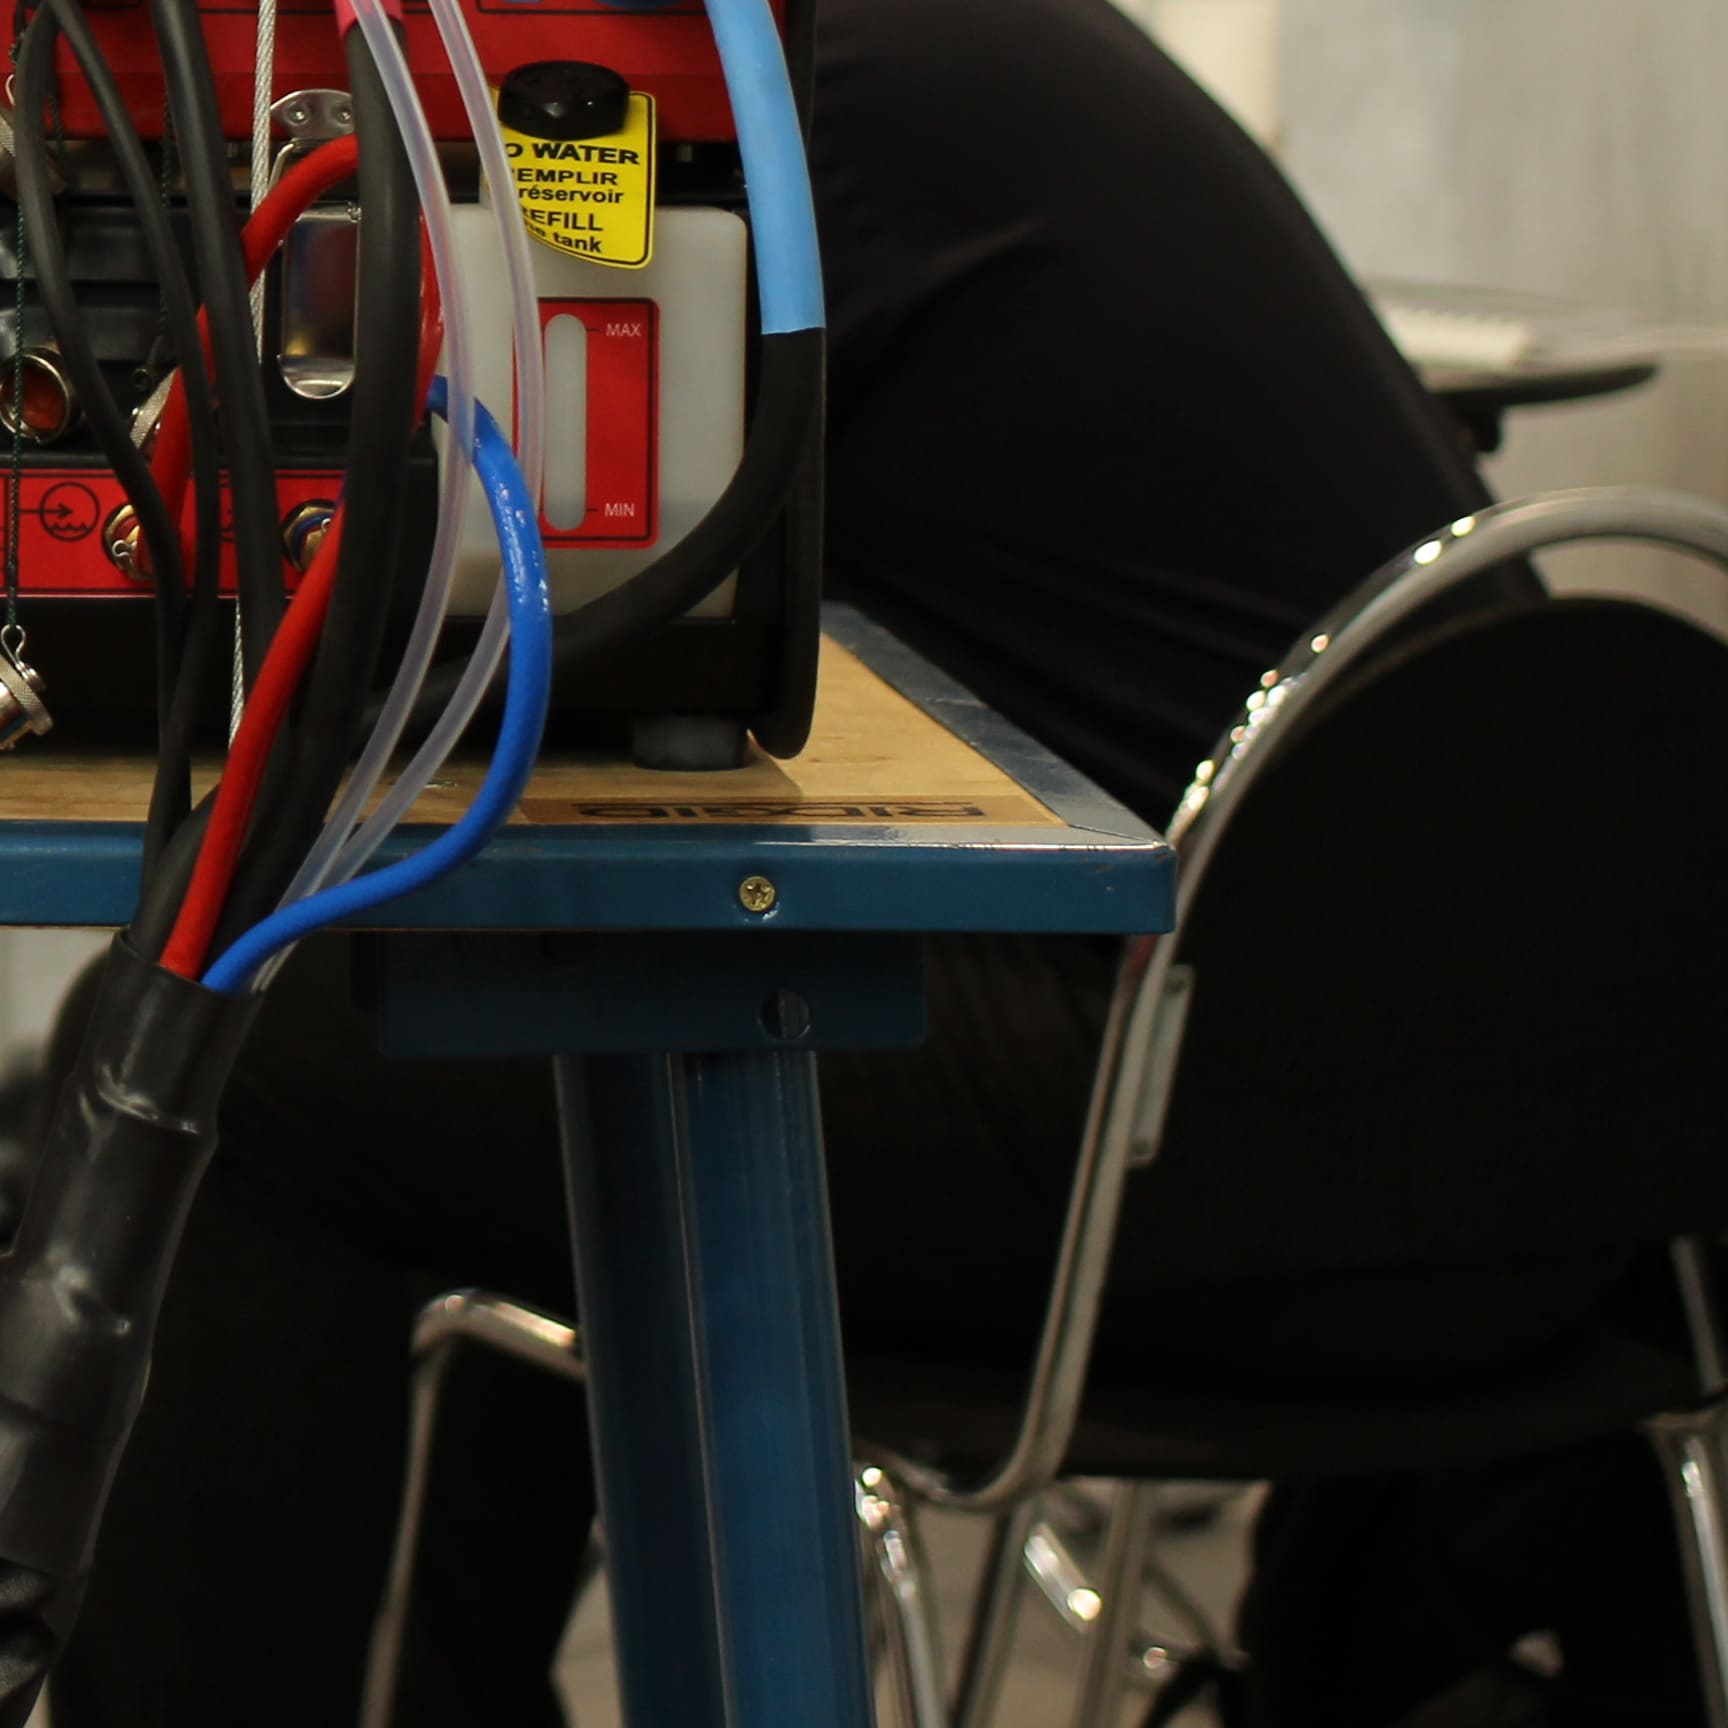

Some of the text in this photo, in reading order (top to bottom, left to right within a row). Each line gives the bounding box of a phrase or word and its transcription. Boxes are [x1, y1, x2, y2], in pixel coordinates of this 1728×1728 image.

[531, 142, 641, 166] WATER
[511, 167, 620, 187] EMPLIR
[519, 184, 625, 205] réservoir
[553, 231, 603, 254] tank
[606, 322, 642, 337] MAX
[604, 503, 635, 517] MIN
